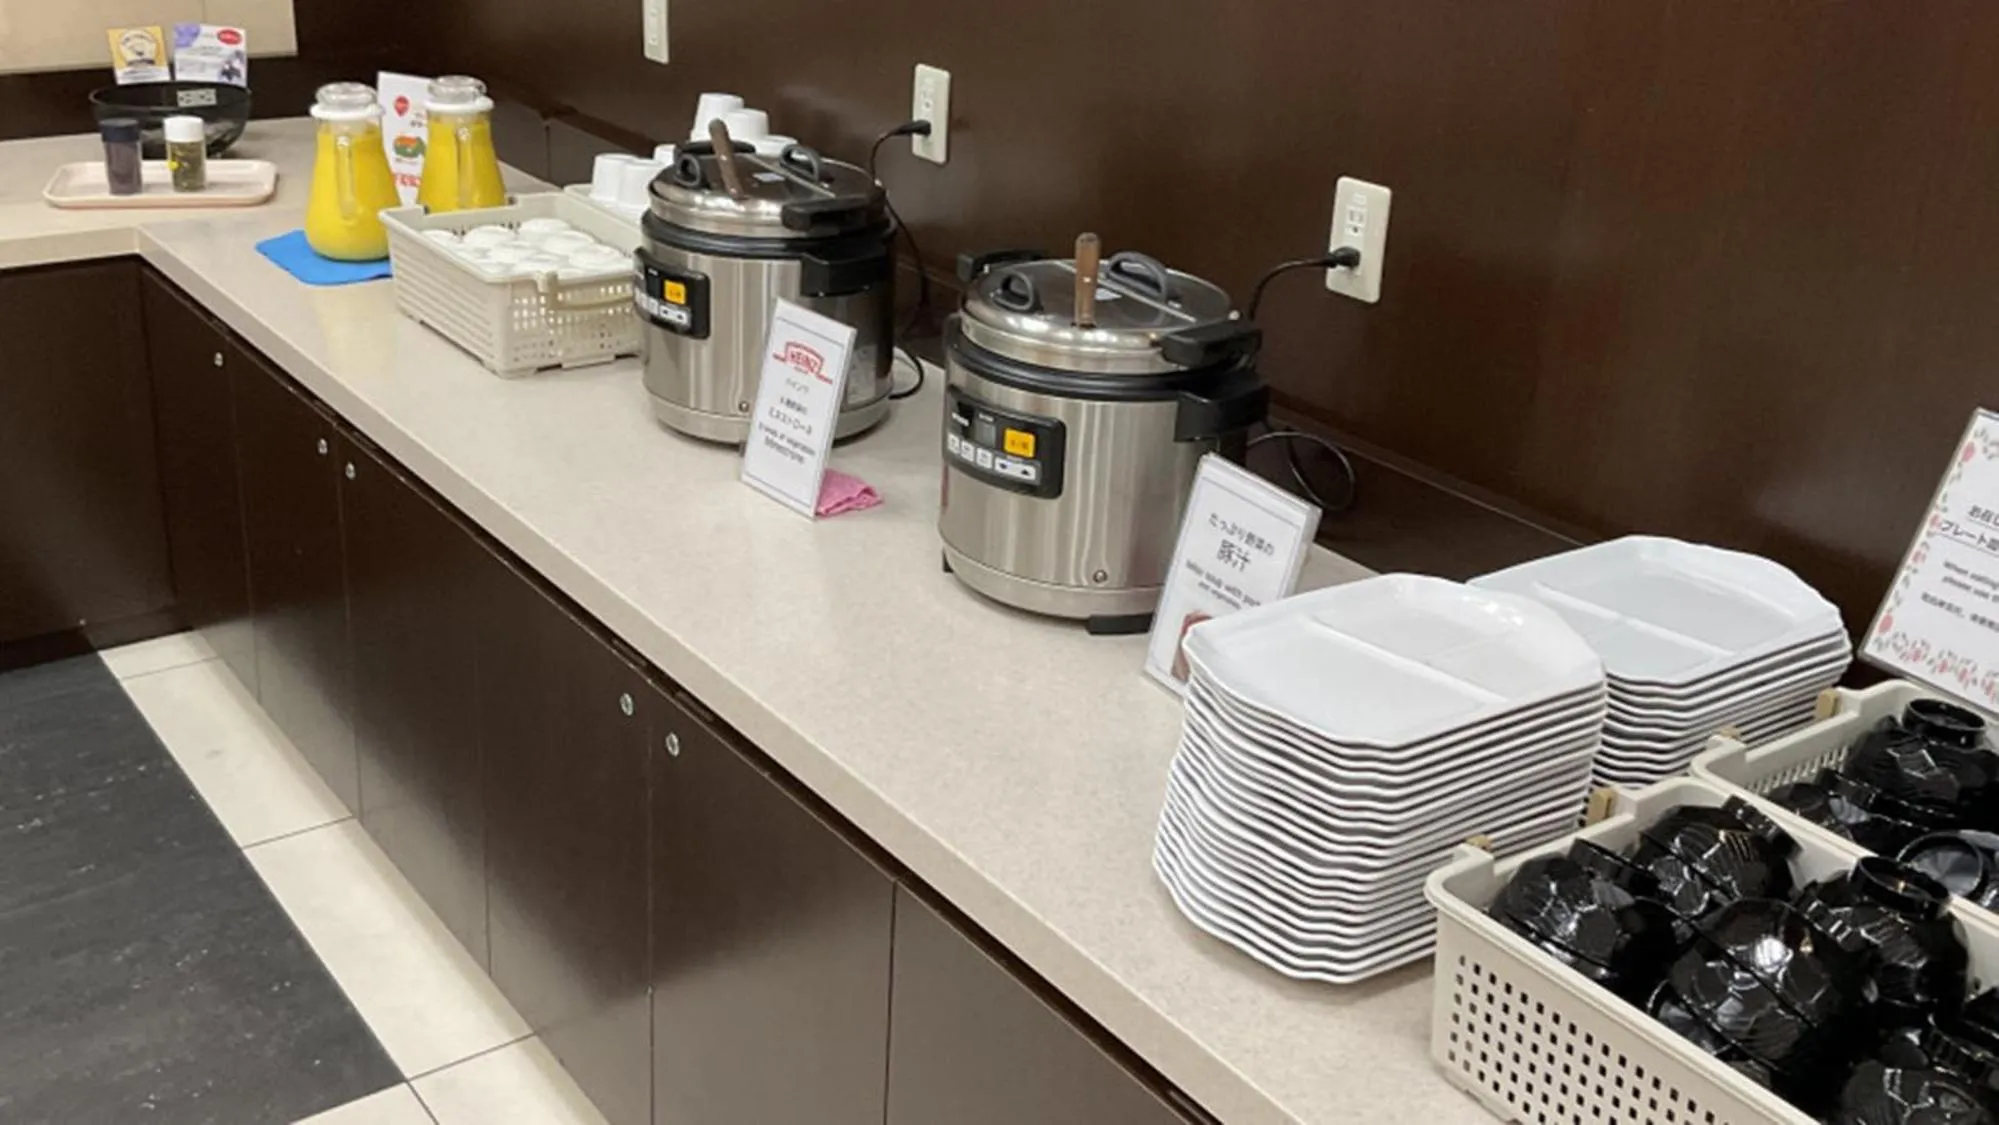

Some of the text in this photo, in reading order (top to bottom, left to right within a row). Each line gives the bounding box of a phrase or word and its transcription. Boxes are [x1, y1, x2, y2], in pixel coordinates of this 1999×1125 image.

[1209, 513, 1274, 556] たっぷり野菜の
[1216, 539, 1250, 572] 豚汁
